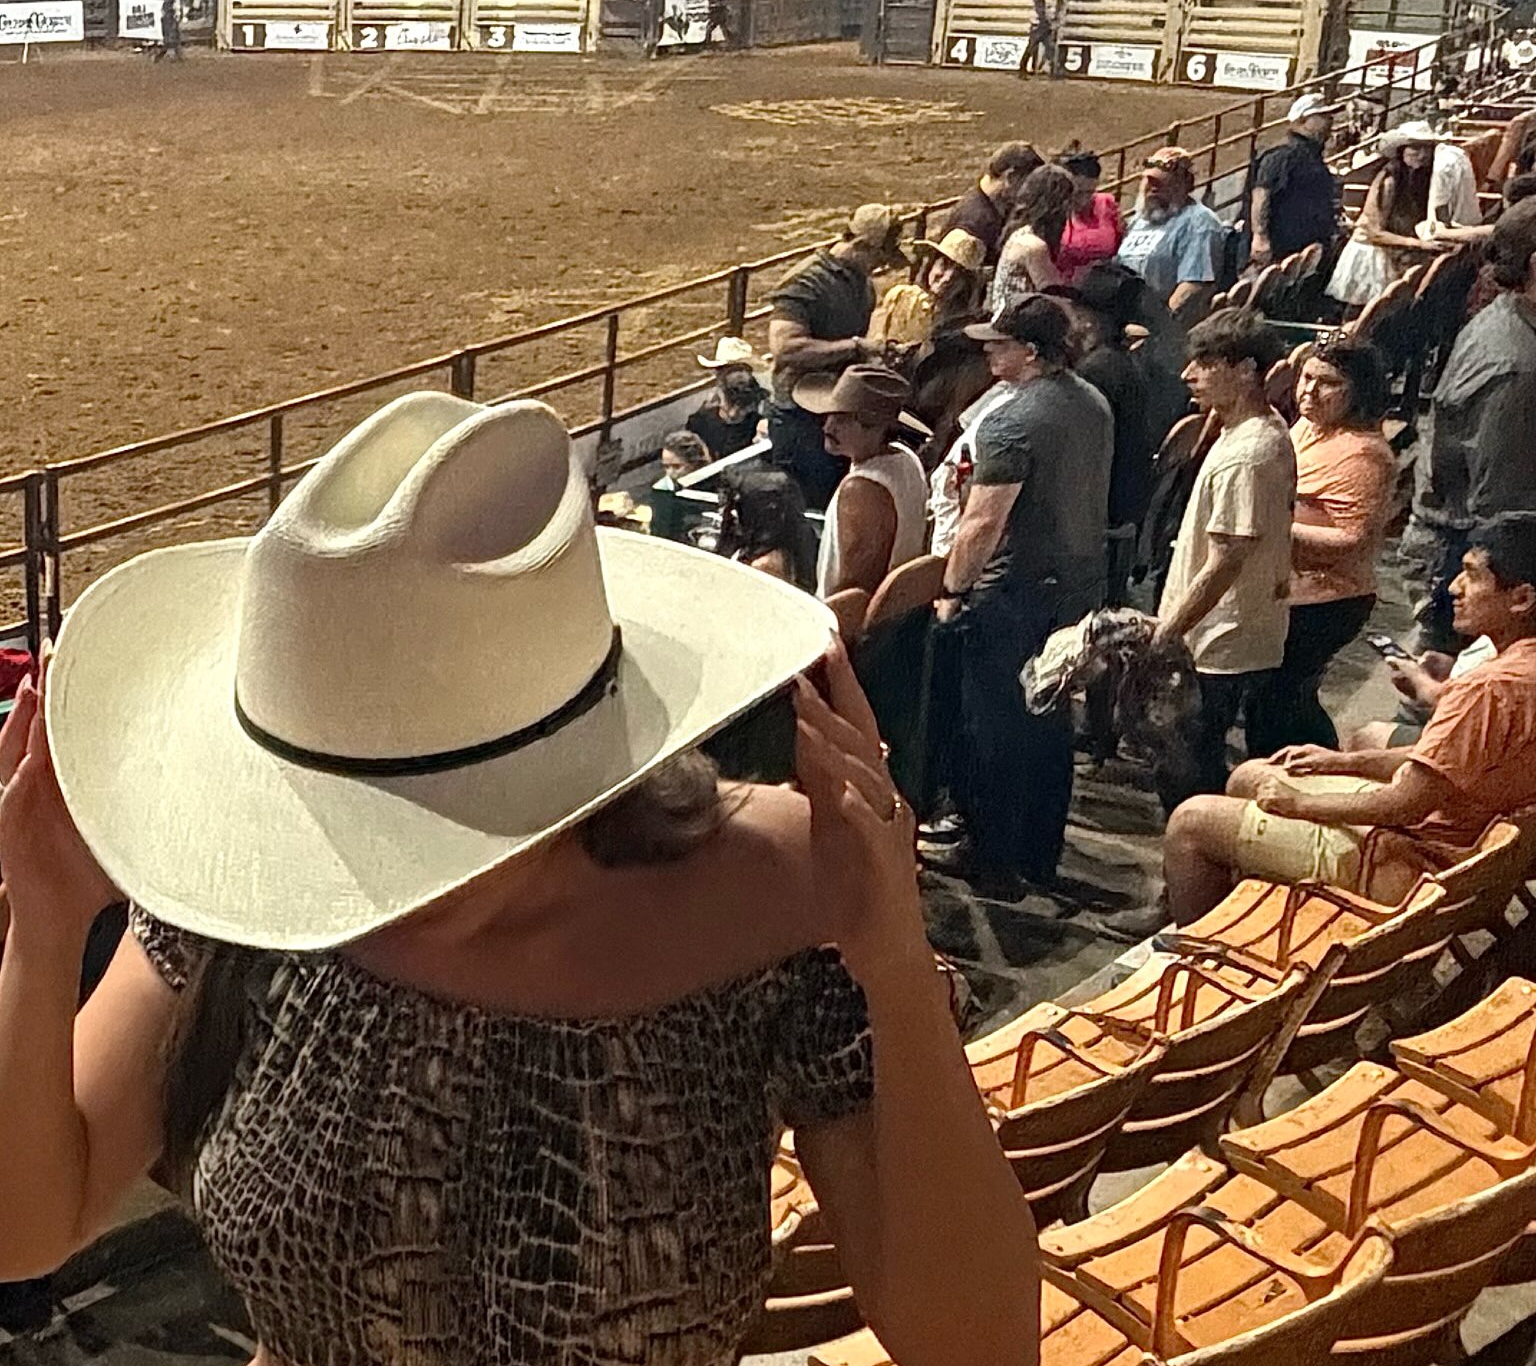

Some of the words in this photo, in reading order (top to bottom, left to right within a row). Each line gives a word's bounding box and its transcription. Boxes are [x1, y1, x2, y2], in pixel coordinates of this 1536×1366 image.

[241, 24, 255, 46] 1
[363, 26, 379, 48] 2
[487, 26, 507, 48] 3
[949, 38, 968, 62] 4
[1064, 46, 1083, 72] 5
[1186, 54, 1208, 81] 6
